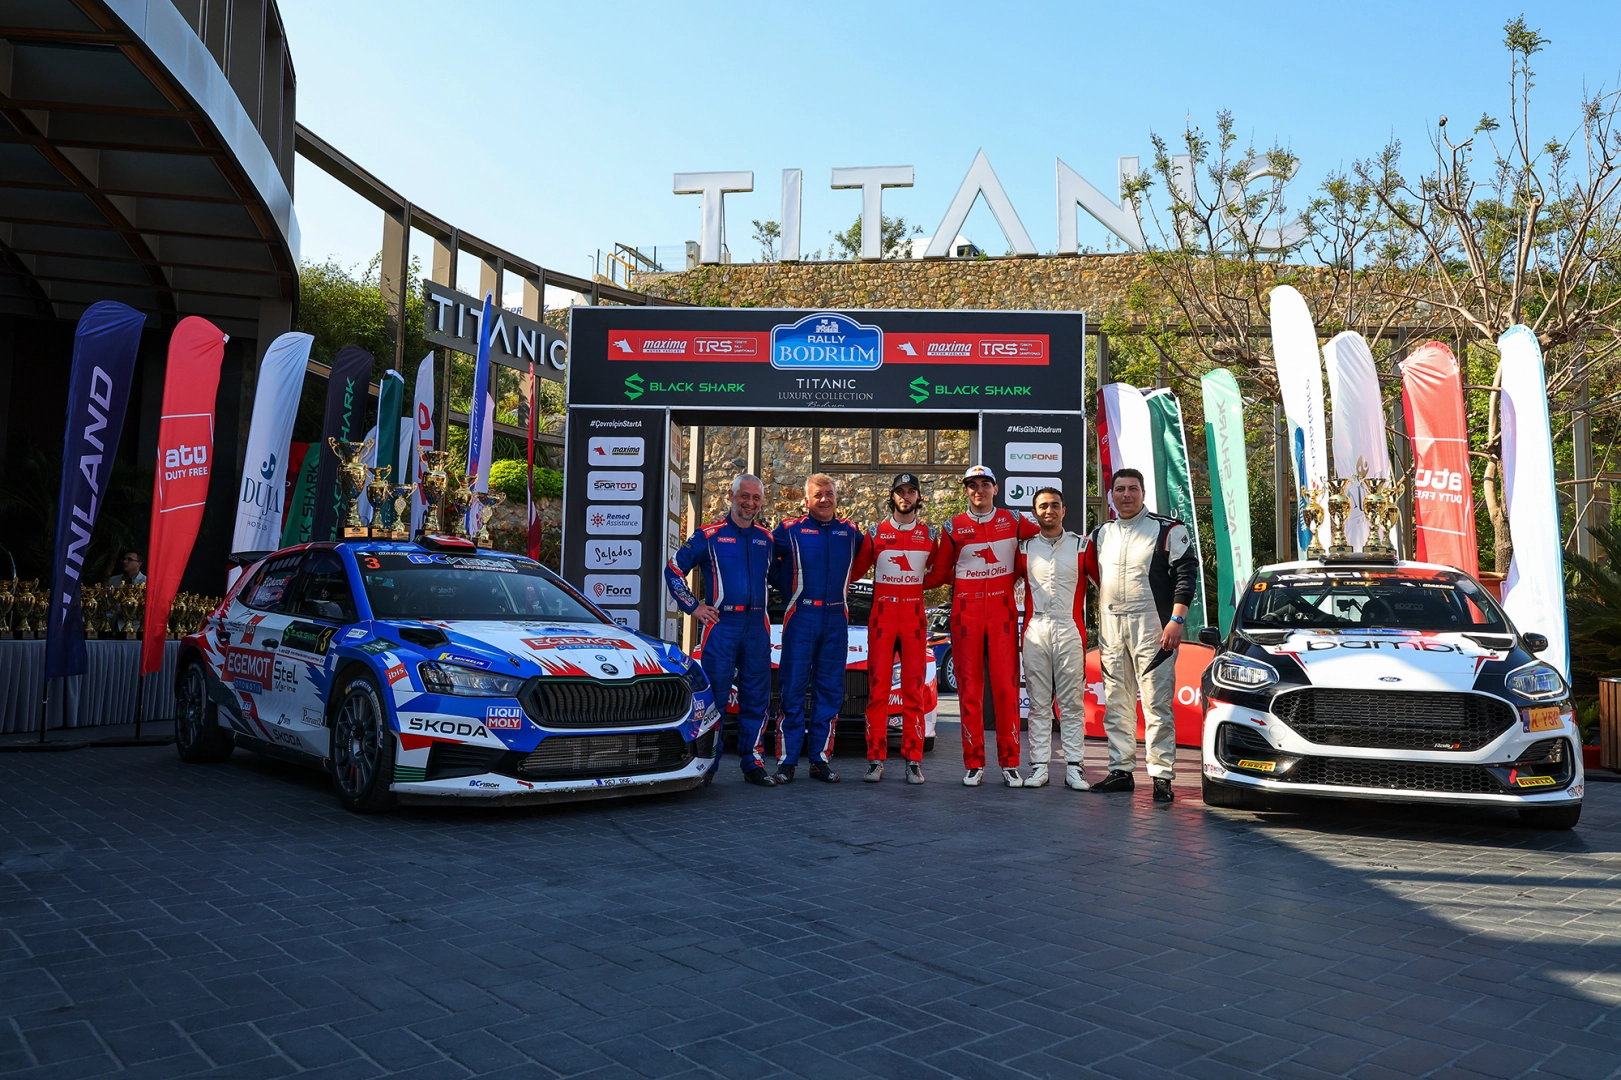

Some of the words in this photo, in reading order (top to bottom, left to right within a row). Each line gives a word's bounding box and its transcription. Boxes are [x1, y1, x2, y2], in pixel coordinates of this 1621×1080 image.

[673, 148, 1301, 264] TITANIC
[431, 293, 566, 370] TITANIC
[643, 338, 687, 349] maxima
[696, 340, 733, 353] TRS
[808, 335, 845, 344] RALLY
[778, 344, 876, 363] BODRUM
[927, 341, 972, 352] maxima
[981, 343, 1018, 356] TRS
[650, 382, 694, 392] BLACK
[699, 382, 745, 393] SHARK
[796, 378, 856, 389] TITANIC
[778, 392, 813, 401] LUXURY
[816, 392, 874, 401] COLLECTION
[935, 385, 980, 395] BLACK
[984, 385, 1031, 396] SHARK
[165, 469, 187, 481] DUTY
[189, 466, 208, 477] FREE
[242, 477, 280, 515] DUJA
[302, 463, 319, 517] SHARK
[606, 519, 638, 527] Assistance
[594, 545, 632, 562] Salados
[364, 557, 381, 569] 3
[966, 569, 989, 577] Petrol
[991, 565, 1007, 576] Ofisi
[882, 574, 903, 583] Petrol
[904, 575, 920, 583] Ofisi
[606, 585, 632, 595] Fora
[1254, 582, 1267, 592] 9
[320, 630, 332, 651] 3
[1307, 640, 1464, 655] bambi
[227, 652, 271, 679] EGEMOT
[454, 656, 485, 667] MICHELIN
[274, 661, 298, 684] Stel
[388, 667, 405, 680] ibis
[274, 681, 297, 693] Marine
[489, 708, 520, 718] LIQUI
[489, 718, 520, 729] MOLY
[1239, 760, 1274, 771] PIRELLI
[1519, 777, 1556, 787] PIRELLI
